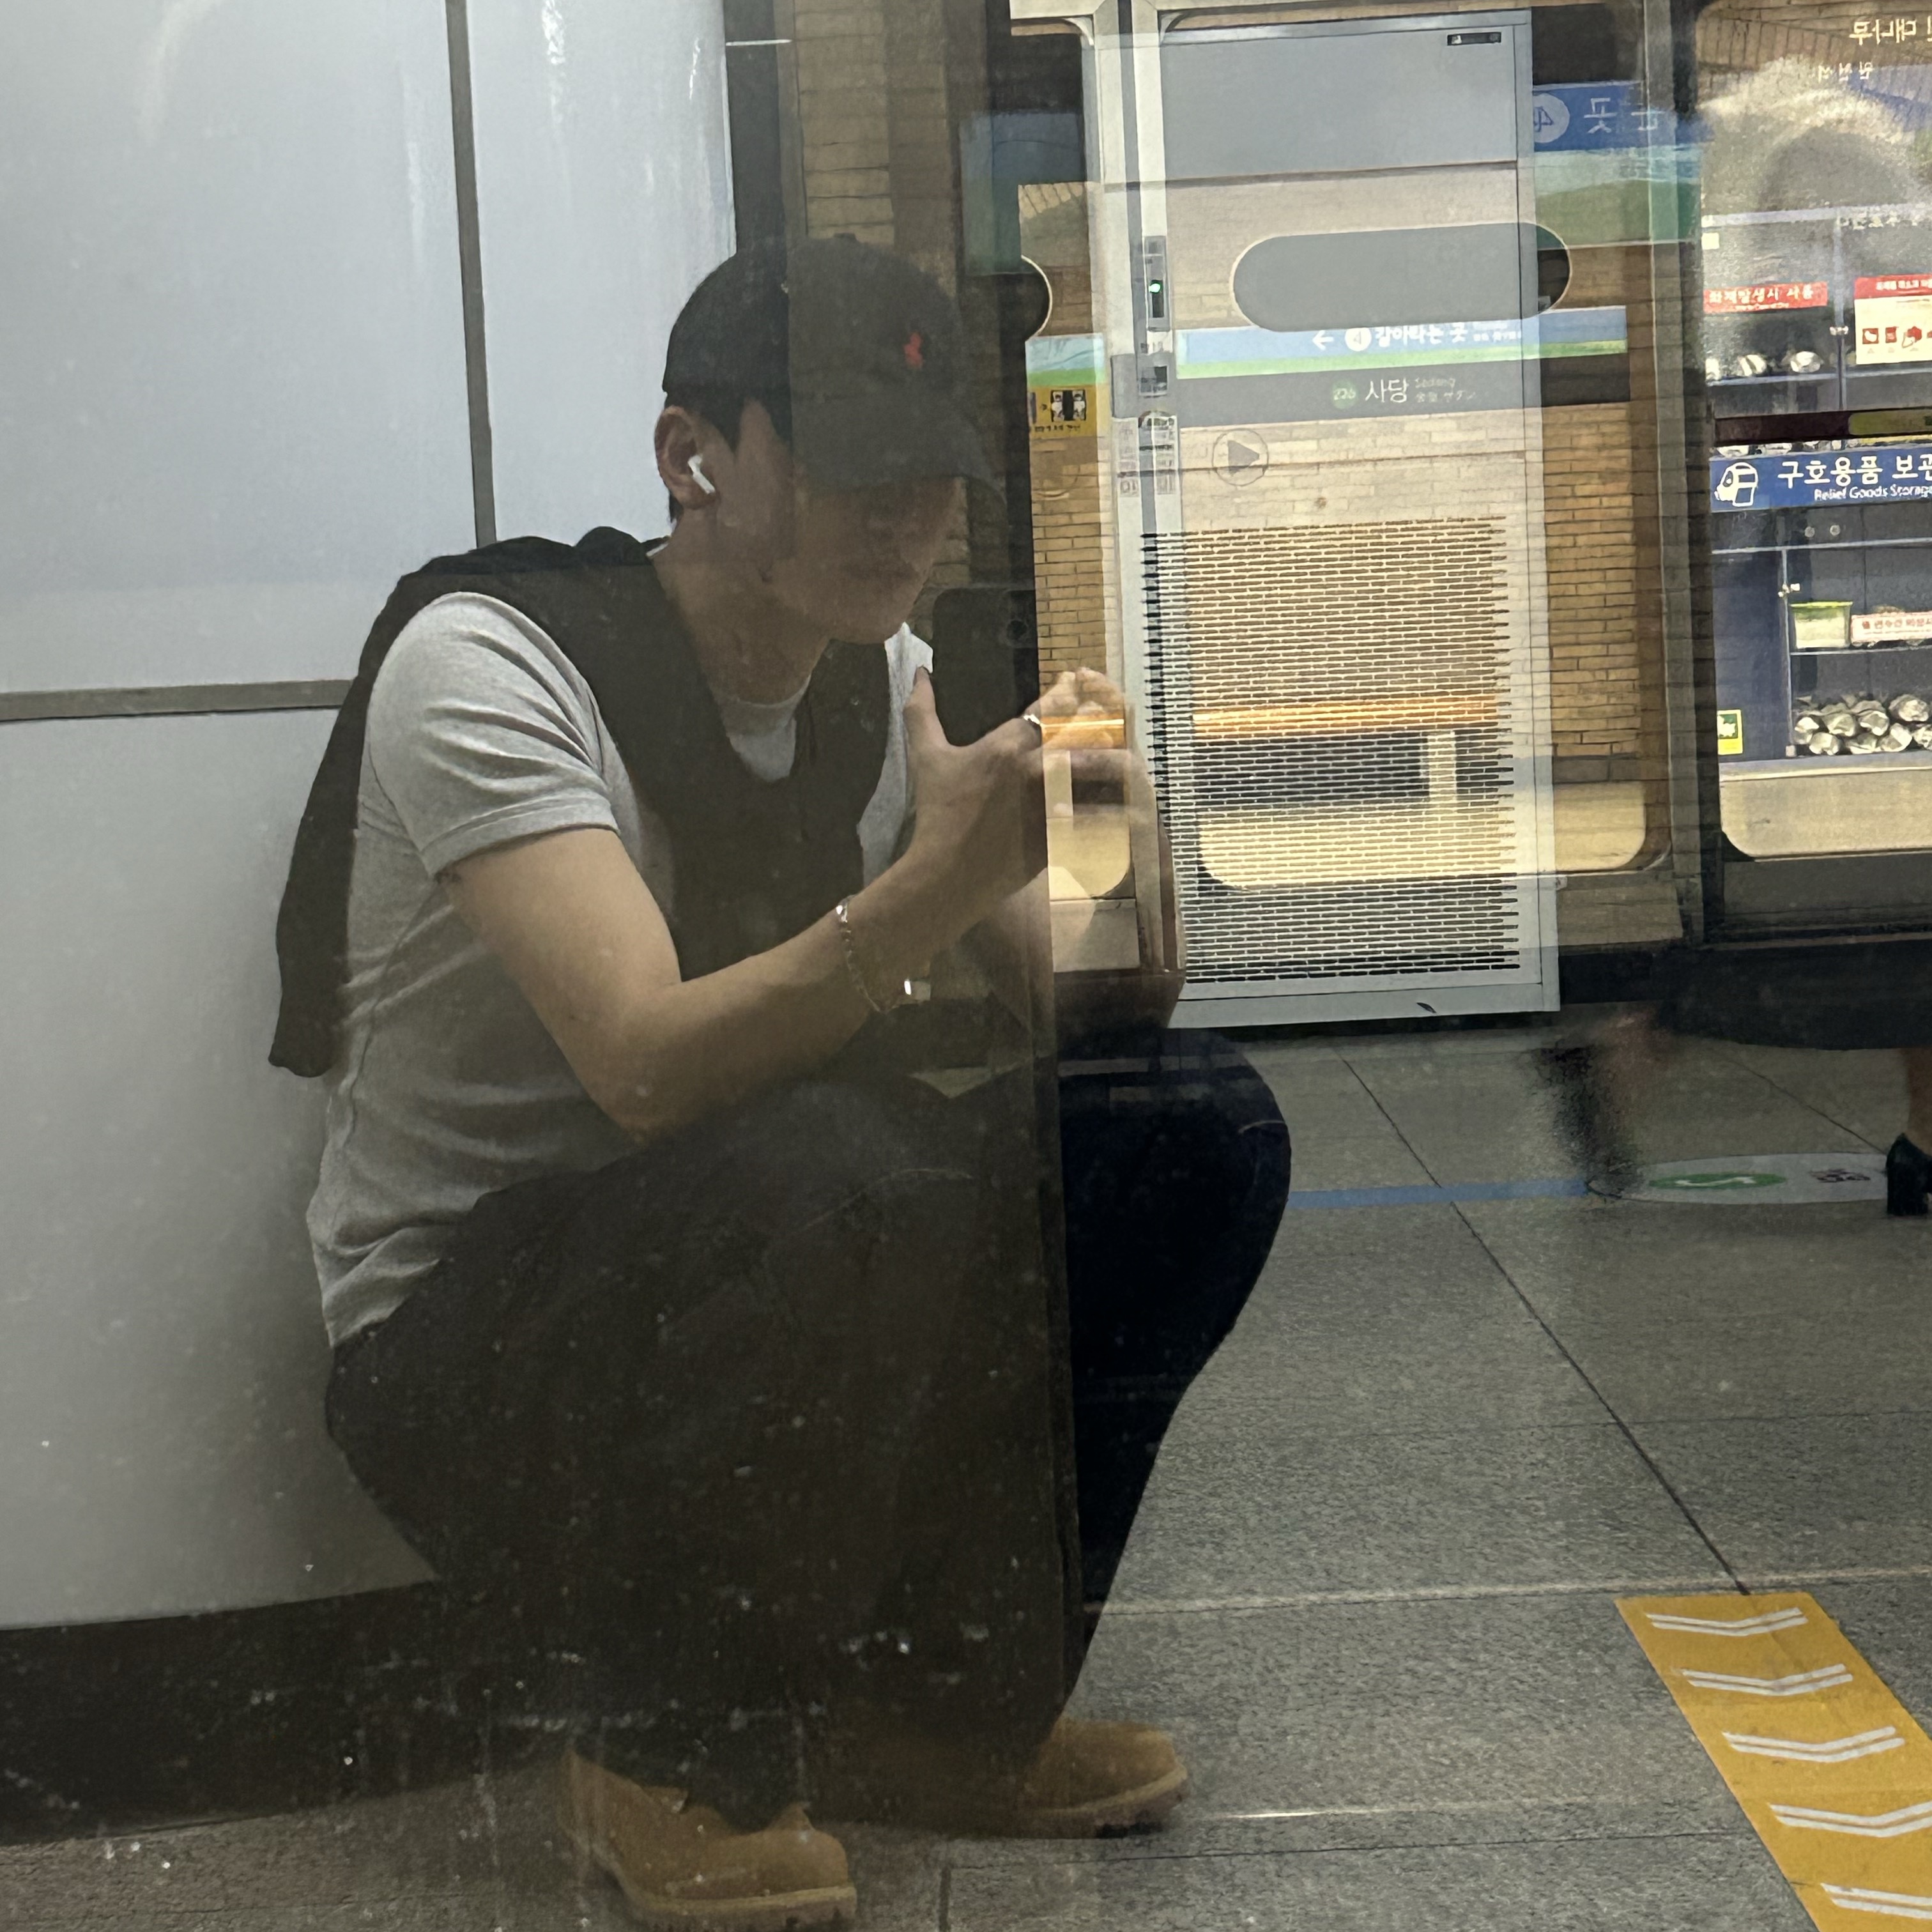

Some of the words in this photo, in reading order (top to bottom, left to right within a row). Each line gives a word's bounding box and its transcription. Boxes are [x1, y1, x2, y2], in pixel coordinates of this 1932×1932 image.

[1365, 378, 1410, 404] 사당
[1777, 456, 1884, 489] 구호용품
[1813, 486, 1847, 502] Relief
[1849, 486, 1888, 499] Goods
